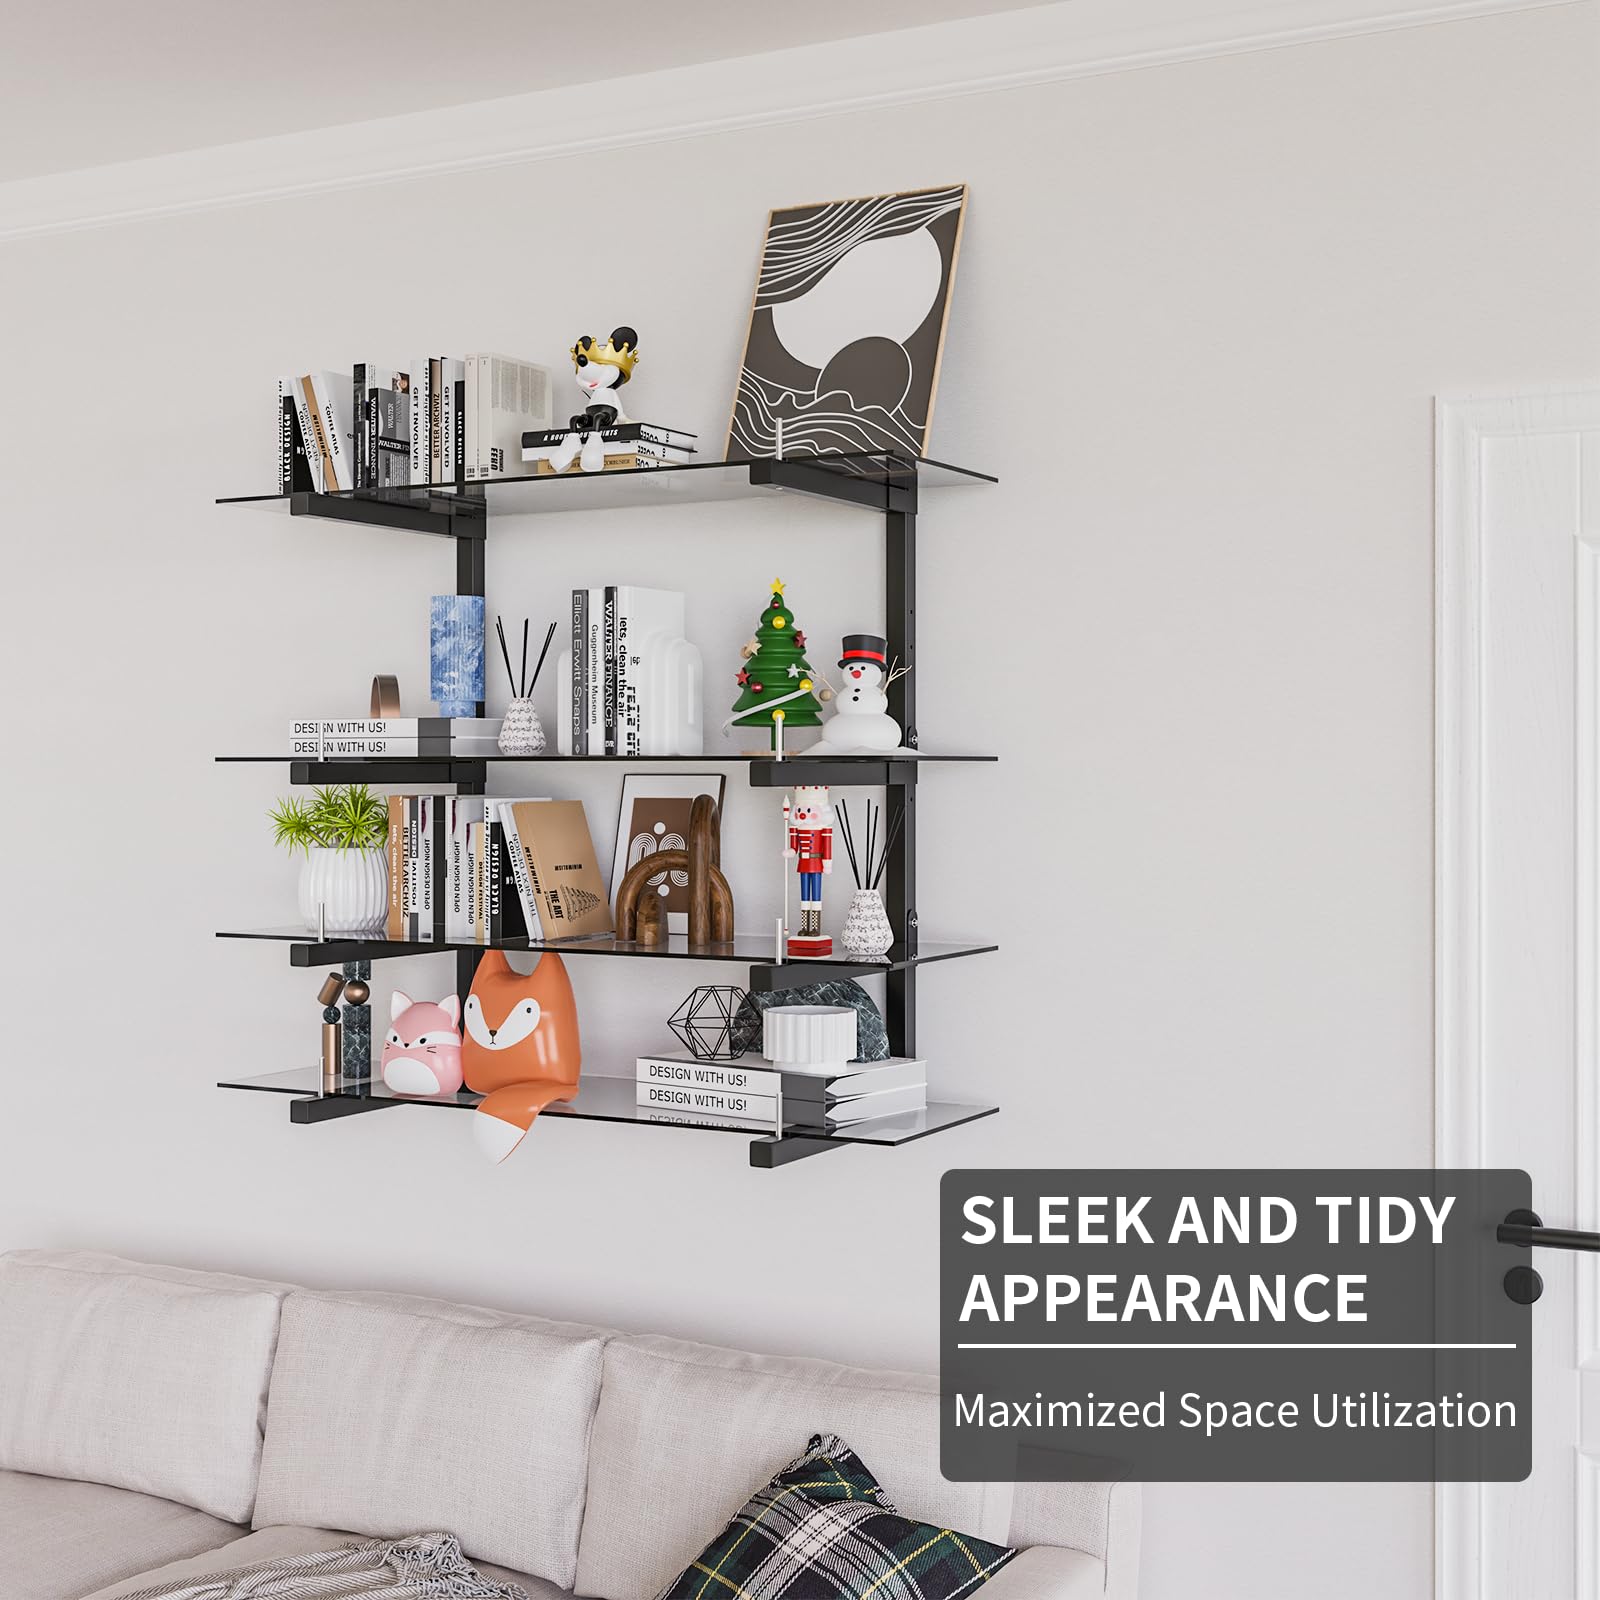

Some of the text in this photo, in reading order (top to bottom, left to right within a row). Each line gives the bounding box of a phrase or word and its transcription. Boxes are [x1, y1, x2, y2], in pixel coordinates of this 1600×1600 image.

[298, 411, 312, 459] COFFEE ATLAS
[326, 406, 334, 431] COFFEE
[331, 434, 340, 455] ATLAS
[618, 618, 627, 641] lets,
[619, 645, 627, 675] clean
[619, 679, 627, 698] the
[573, 686, 582, 735] Snaps
[337, 723, 364, 733] WITH
[369, 722, 386, 732] US!
[337, 742, 364, 752] WITH
[369, 742, 386, 752] US!
[509, 841, 518, 870] COFFEE
[512, 834, 525, 869] DESIGN
[522, 873, 531, 896] NEXT
[525, 847, 541, 894] MINIMALISM
[549, 890, 564, 918] THE ART
[650, 1065, 747, 1086] DESIGN WITH US!
[650, 1089, 747, 1111] DESIGN WITH US!
